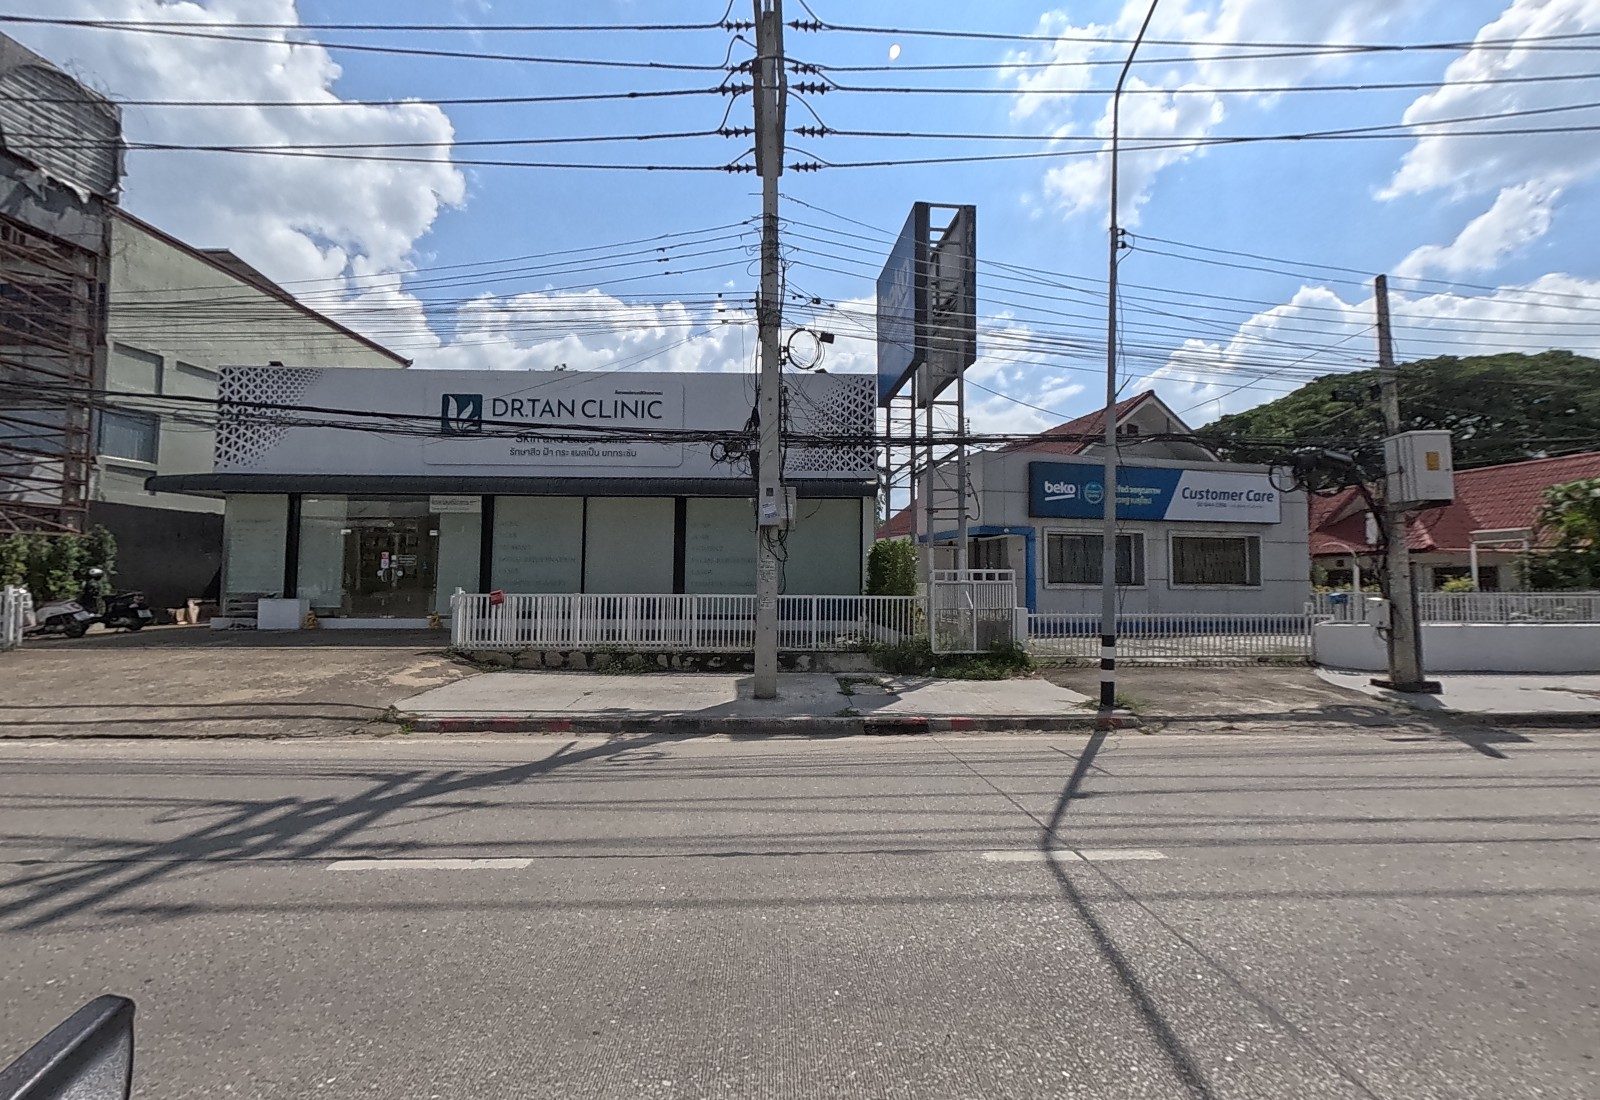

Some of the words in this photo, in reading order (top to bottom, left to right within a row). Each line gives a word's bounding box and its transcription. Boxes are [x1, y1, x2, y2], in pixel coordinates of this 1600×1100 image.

[491, 398, 576, 418] DR.TAN
[581, 399, 663, 419] CLINIC
[1044, 480, 1077, 494] beko
[1181, 487, 1244, 501] Customer
[1246, 489, 1275, 502] Care
